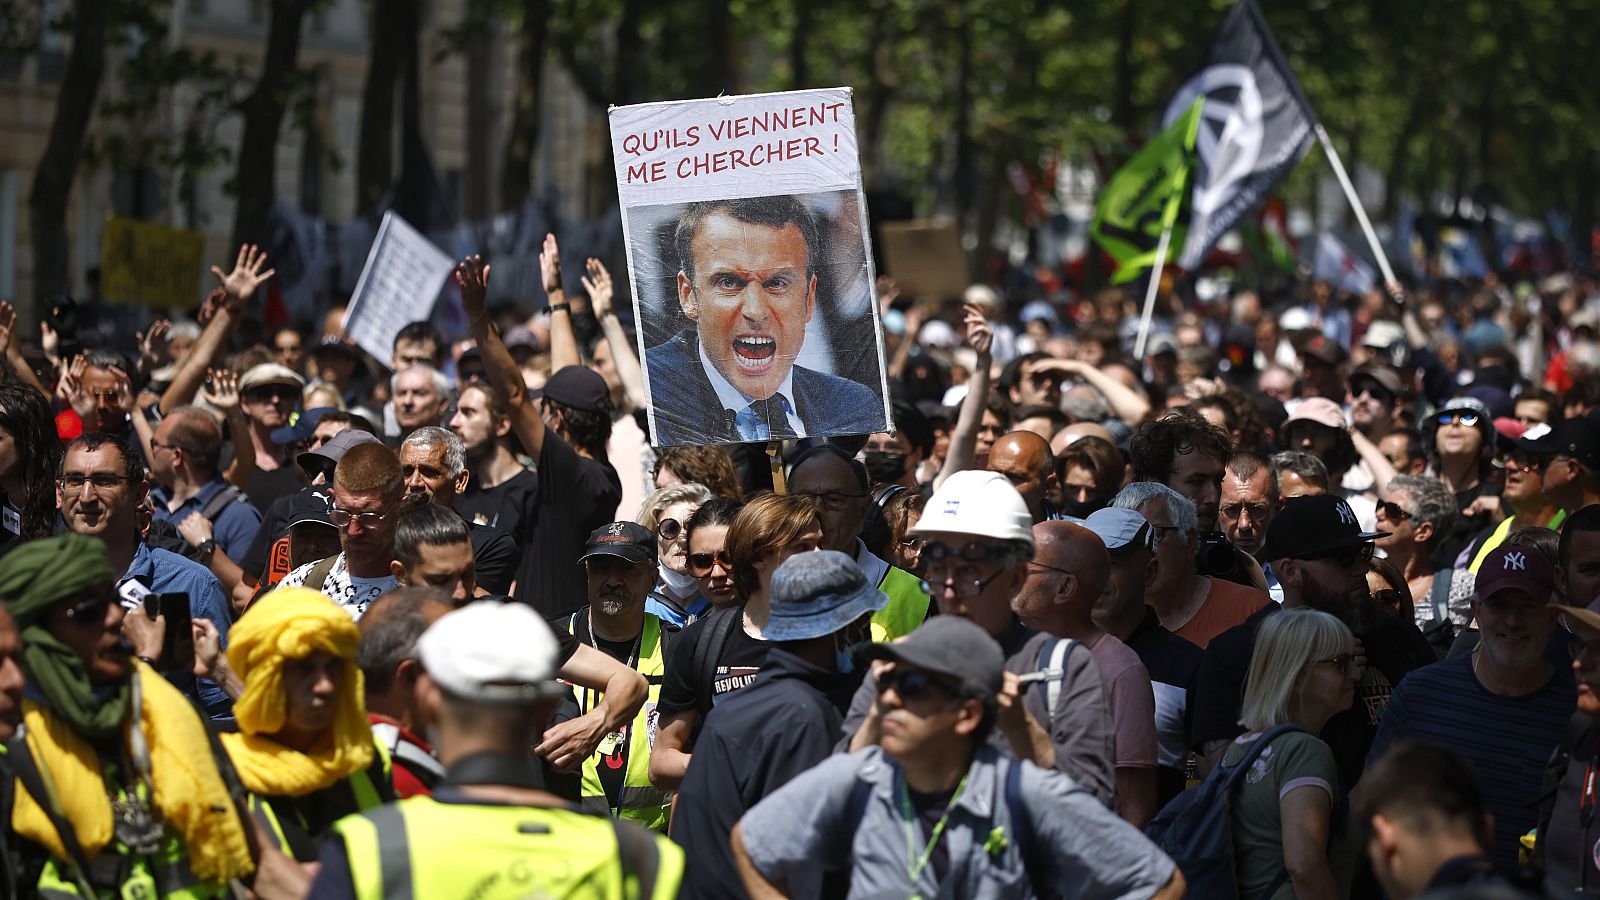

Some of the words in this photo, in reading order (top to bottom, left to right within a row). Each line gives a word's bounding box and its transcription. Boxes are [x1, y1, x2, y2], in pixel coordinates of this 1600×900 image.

[622, 125, 701, 156] QU'ILS
[708, 102, 845, 141] VIENNENT
[626, 161, 667, 184] ME
[676, 136, 825, 179] CHERCHER
[833, 133, 839, 153] !
[1503, 551, 1526, 570] NY
